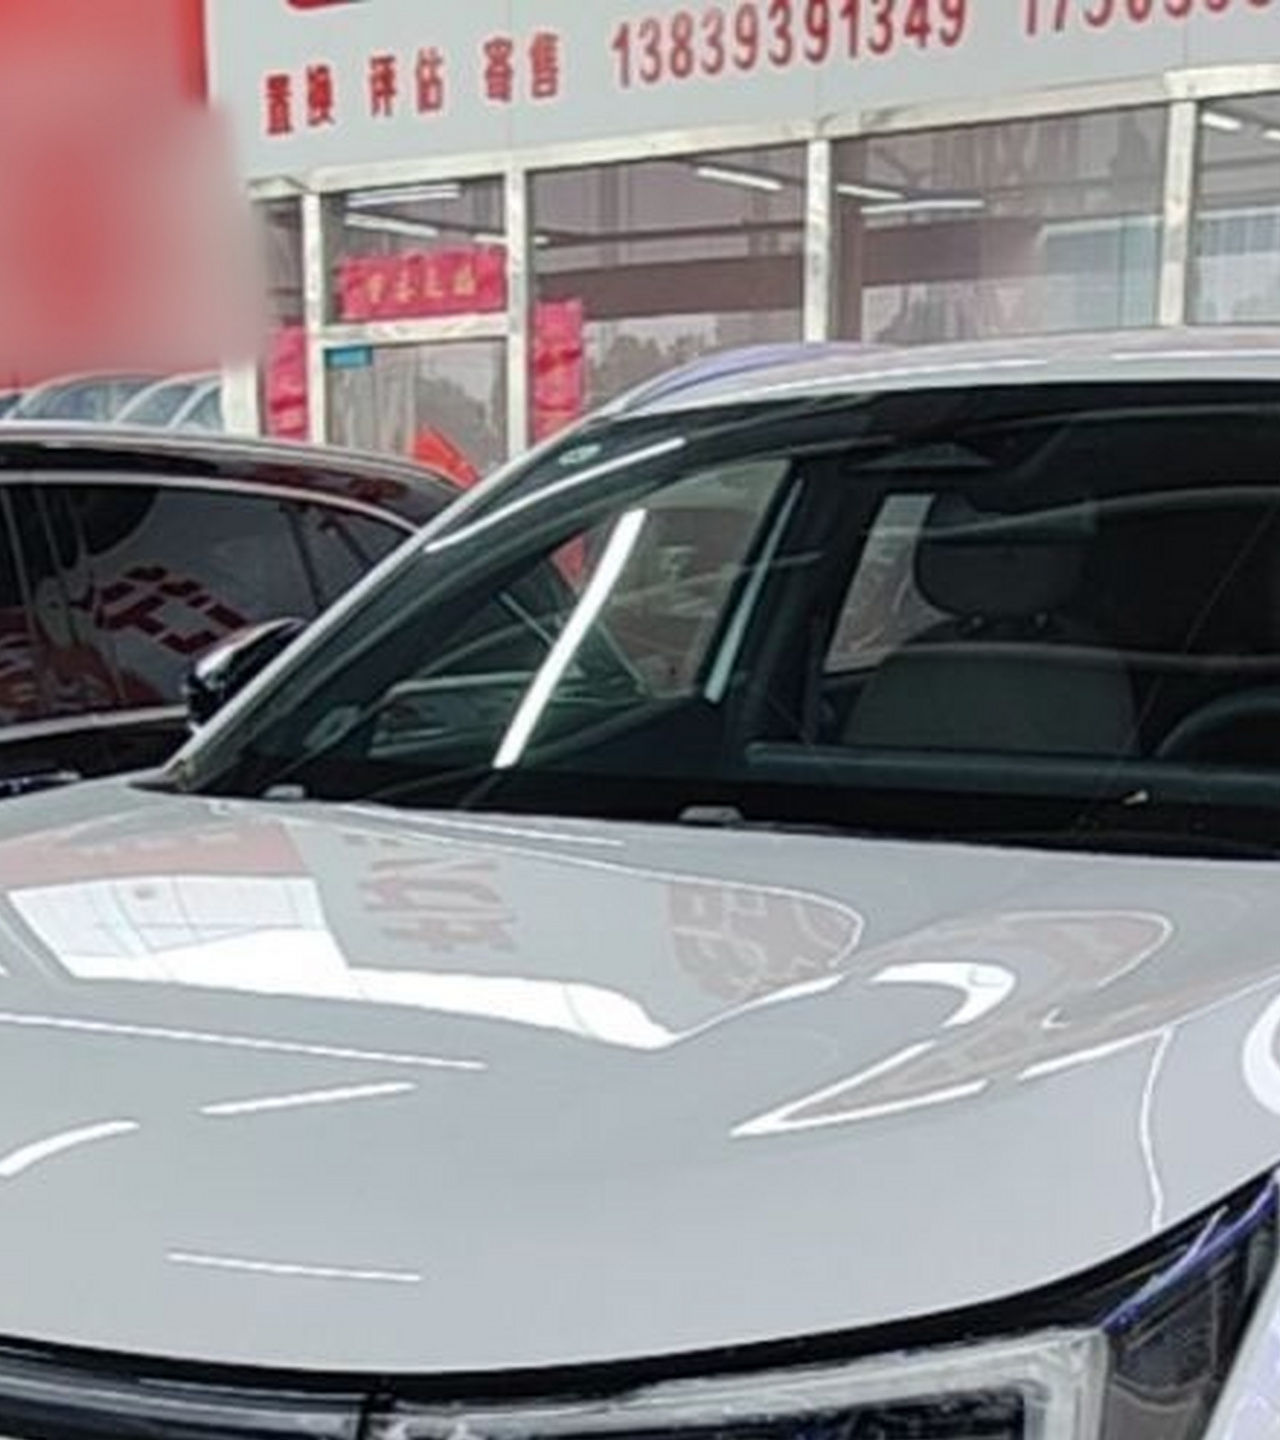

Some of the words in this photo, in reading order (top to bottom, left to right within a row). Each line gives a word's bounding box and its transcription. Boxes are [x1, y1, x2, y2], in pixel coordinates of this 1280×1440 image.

[369, 46, 444, 118] 评估
[483, 32, 560, 102] 寄售
[611, 0, 966, 88] 13839391349
